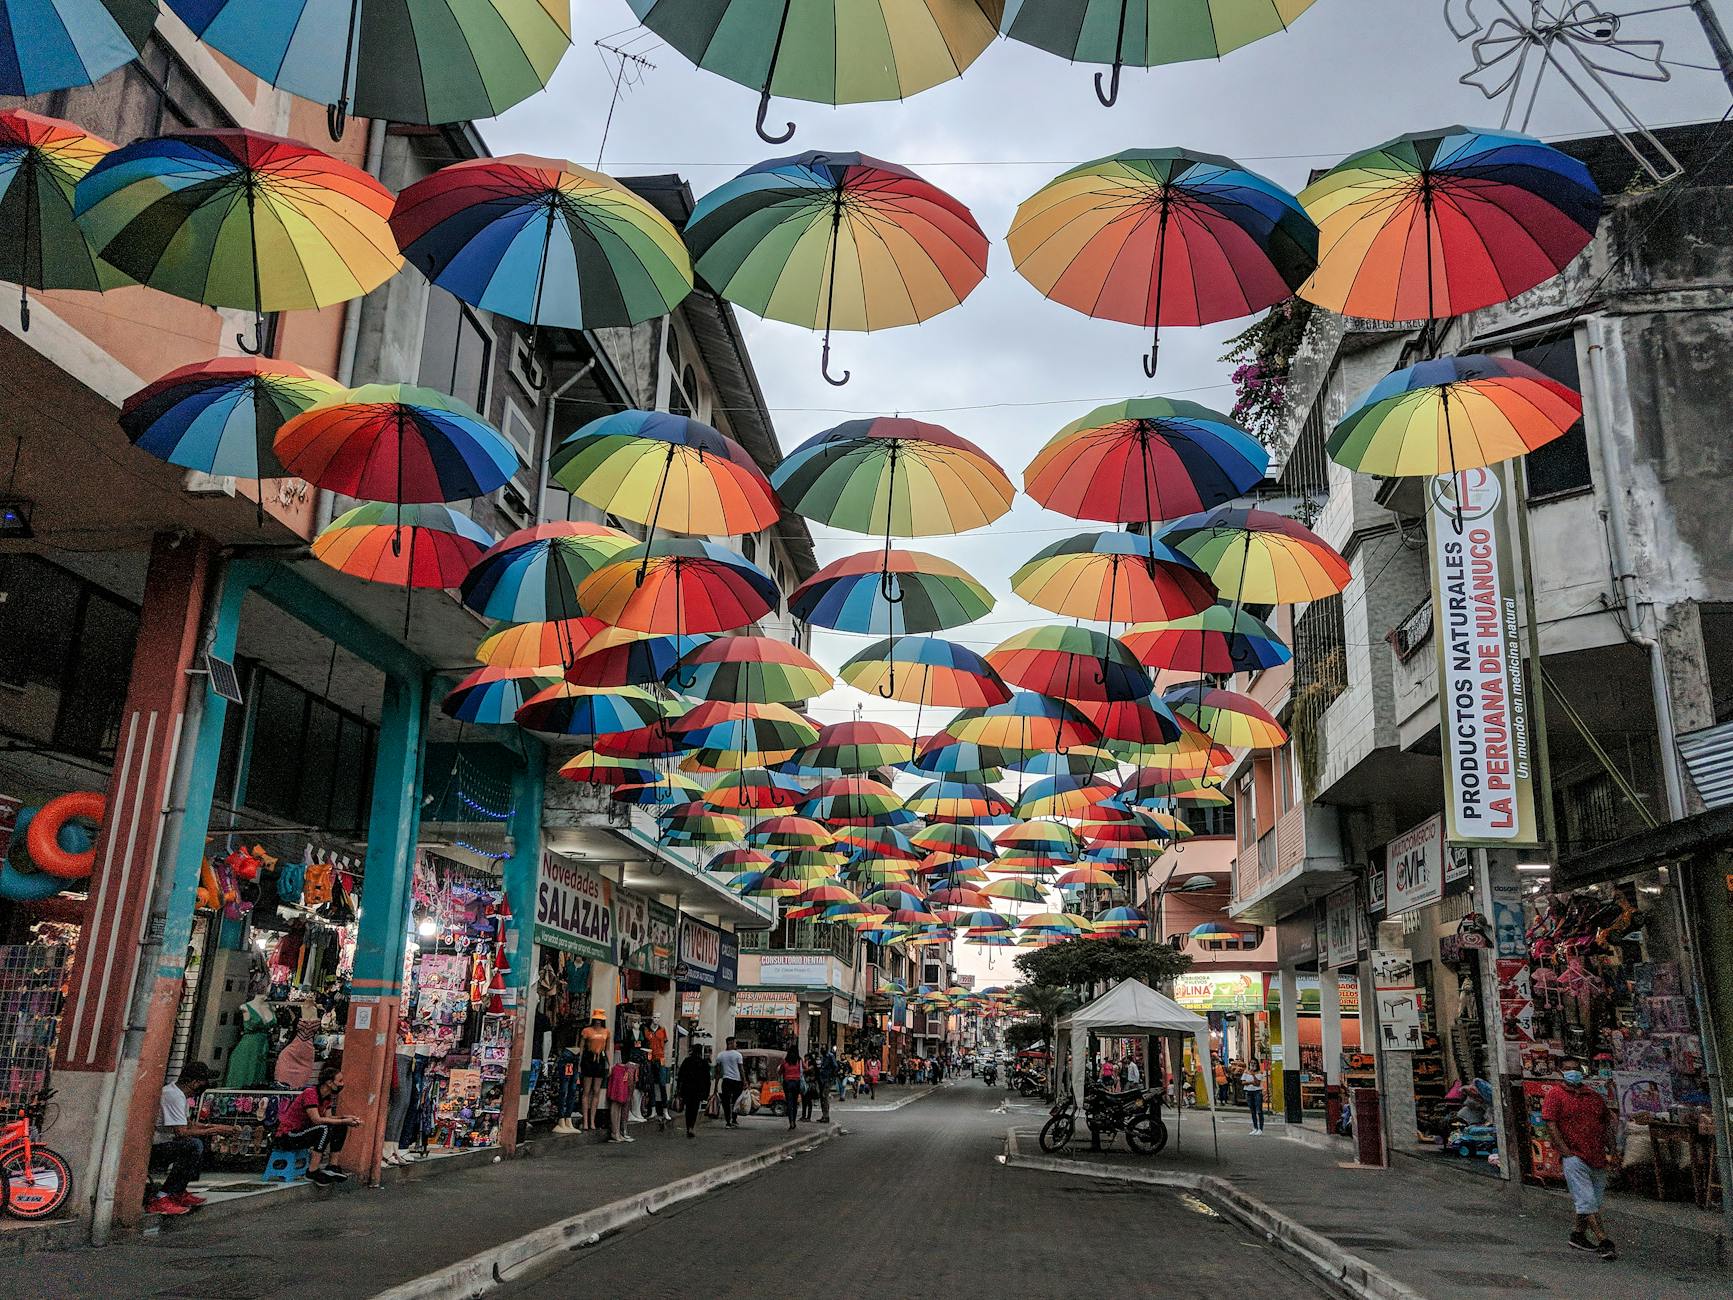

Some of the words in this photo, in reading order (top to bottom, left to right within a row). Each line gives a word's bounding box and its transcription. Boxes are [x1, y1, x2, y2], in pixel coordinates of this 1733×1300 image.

[1468, 528, 1499, 638] HUÁNUCO
[1444, 542, 1471, 671] NATURALES
[1502, 597, 1518, 639] natural
[1478, 644, 1502, 674] DE
[1508, 642, 1523, 697] medicina
[1513, 697, 1524, 713] en
[1454, 679, 1482, 819] PRODUCTOS
[1480, 677, 1511, 790] PERUANA
[1513, 717, 1527, 757] mundo
[1517, 764, 1529, 779] Un
[1489, 797, 1514, 828] LA
[542, 852, 599, 899] Novedades
[537, 882, 610, 943] SALAZAR
[761, 955, 803, 965] CONSULTORIO
